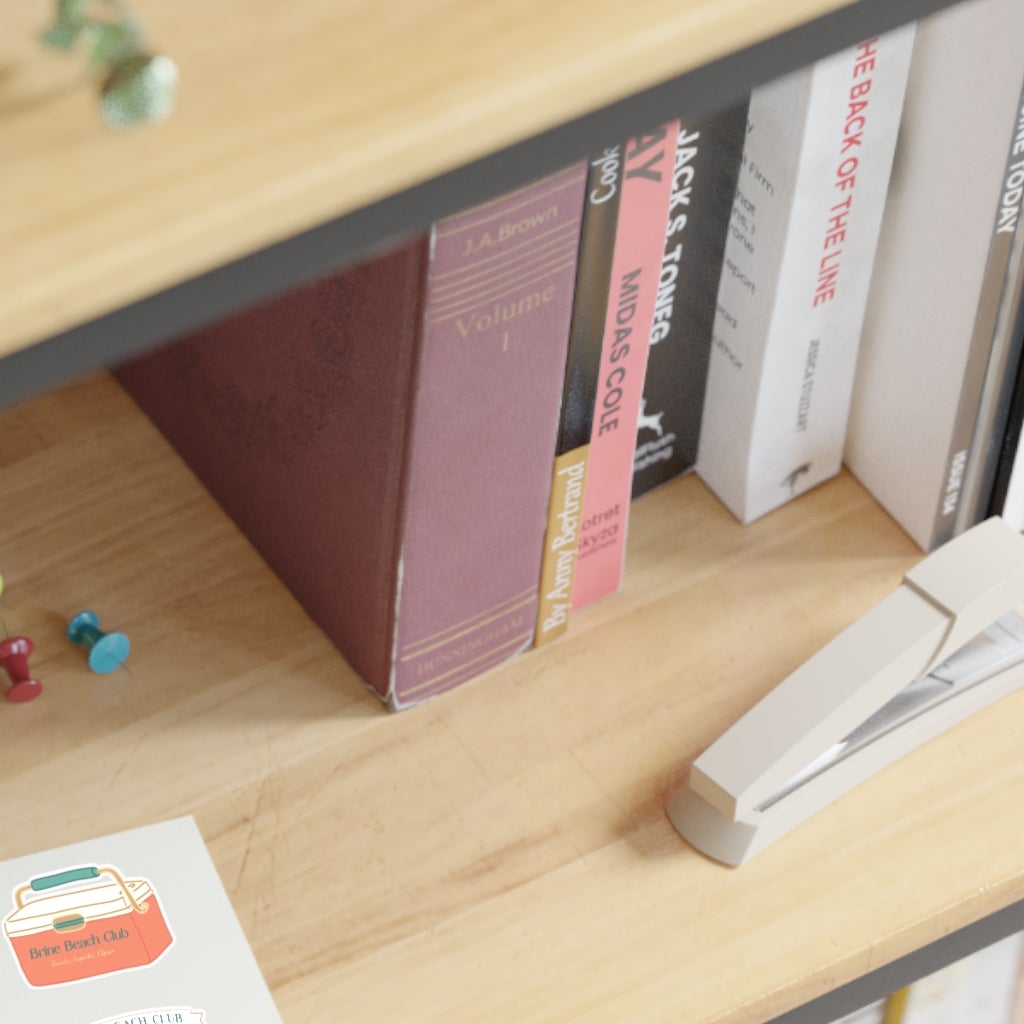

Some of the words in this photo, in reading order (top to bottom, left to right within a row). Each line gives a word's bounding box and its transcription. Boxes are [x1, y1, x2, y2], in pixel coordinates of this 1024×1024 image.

[840, 79, 873, 154] BACK
[589, 143, 620, 204] Cook
[668, 128, 700, 212] JACK
[835, 157, 859, 191] OF
[996, 160, 1024, 234] TODAY
[823, 194, 852, 251] THE
[812, 249, 843, 308] LINE
[455, 285, 556, 338] Volume
[609, 267, 643, 363] MIDAS
[598, 366, 626, 437] COLE
[551, 460, 585, 551] Bertrand
[547, 548, 579, 600] Anny
[542, 603, 573, 633] By
[29, 943, 61, 960] Brine
[64, 934, 100, 952] Beach
[103, 928, 130, 942] Club
[152, 1013, 183, 1024] CLUB
